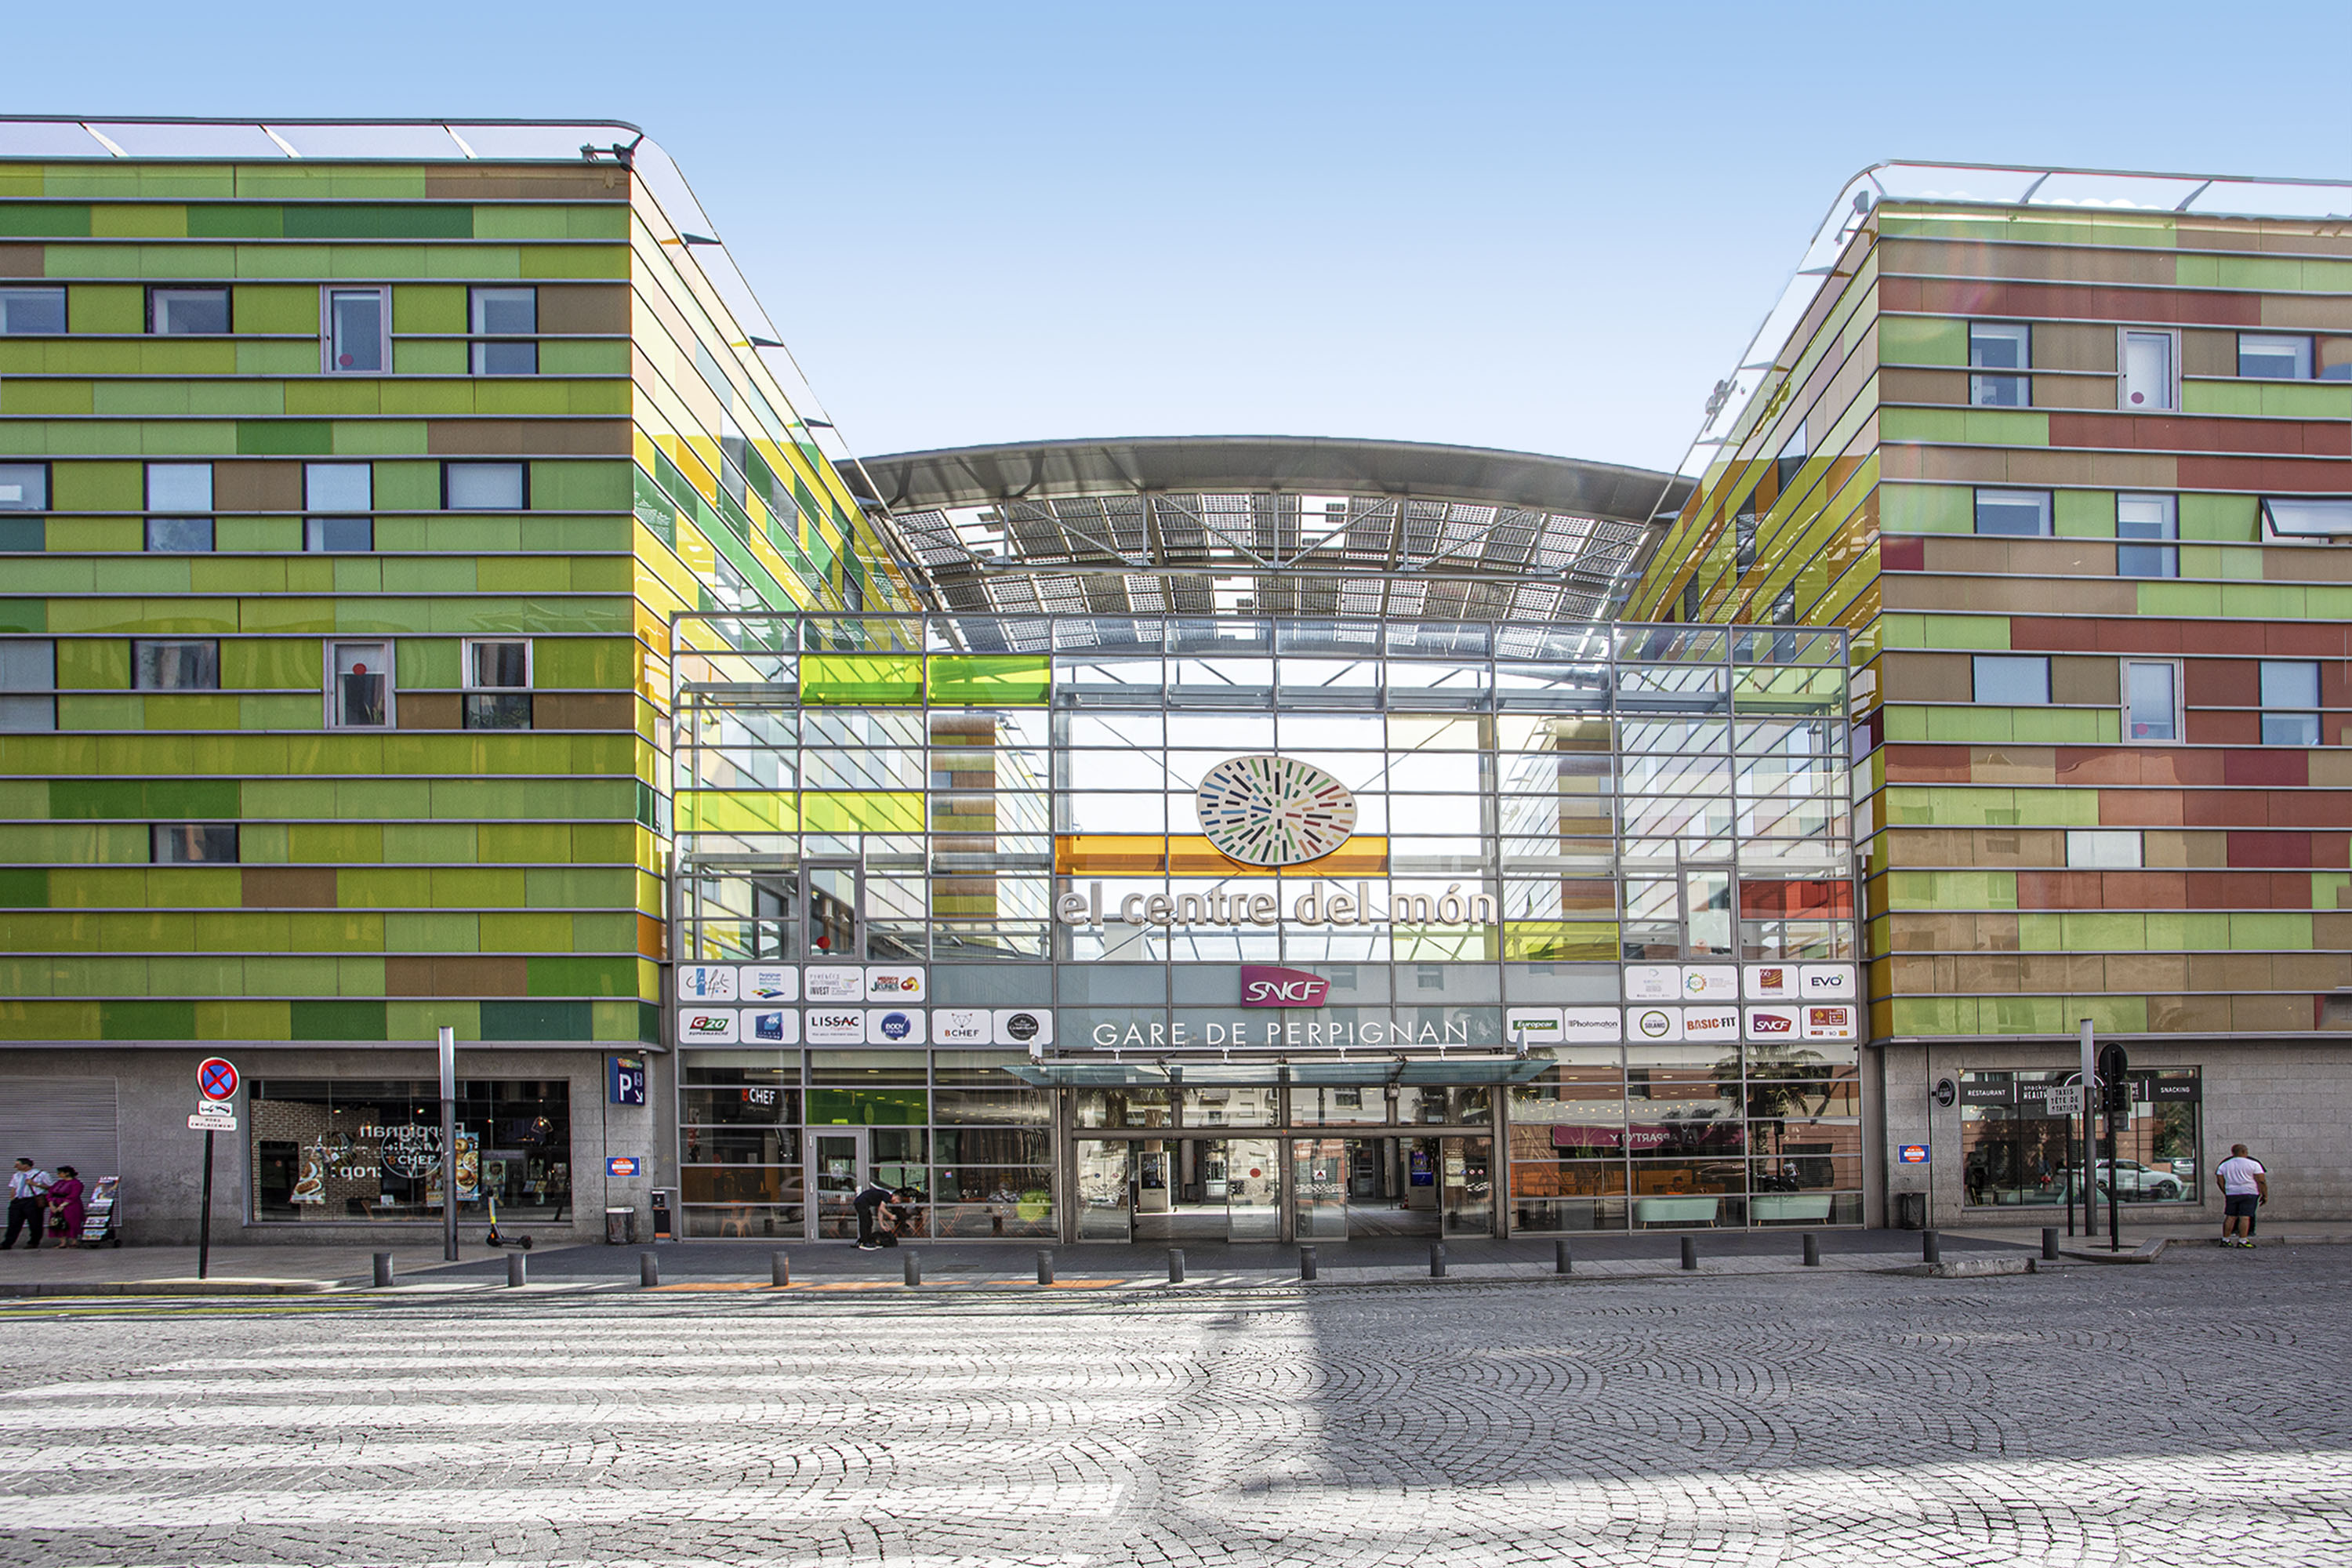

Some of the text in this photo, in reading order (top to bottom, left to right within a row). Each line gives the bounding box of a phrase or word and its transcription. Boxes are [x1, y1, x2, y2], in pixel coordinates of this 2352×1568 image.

[1056, 880, 1499, 927] el centre del món
[1811, 977, 1842, 986] EVO
[810, 986, 829, 995] INVEST
[1246, 981, 1325, 1002] SNCF
[693, 1018, 724, 1029] G20
[811, 1016, 859, 1027] LISSAC
[1755, 1021, 1789, 1030] SNCF
[1093, 1021, 1468, 1047] GARE DE PERPIGNAN
[619, 1073, 632, 1102] P
